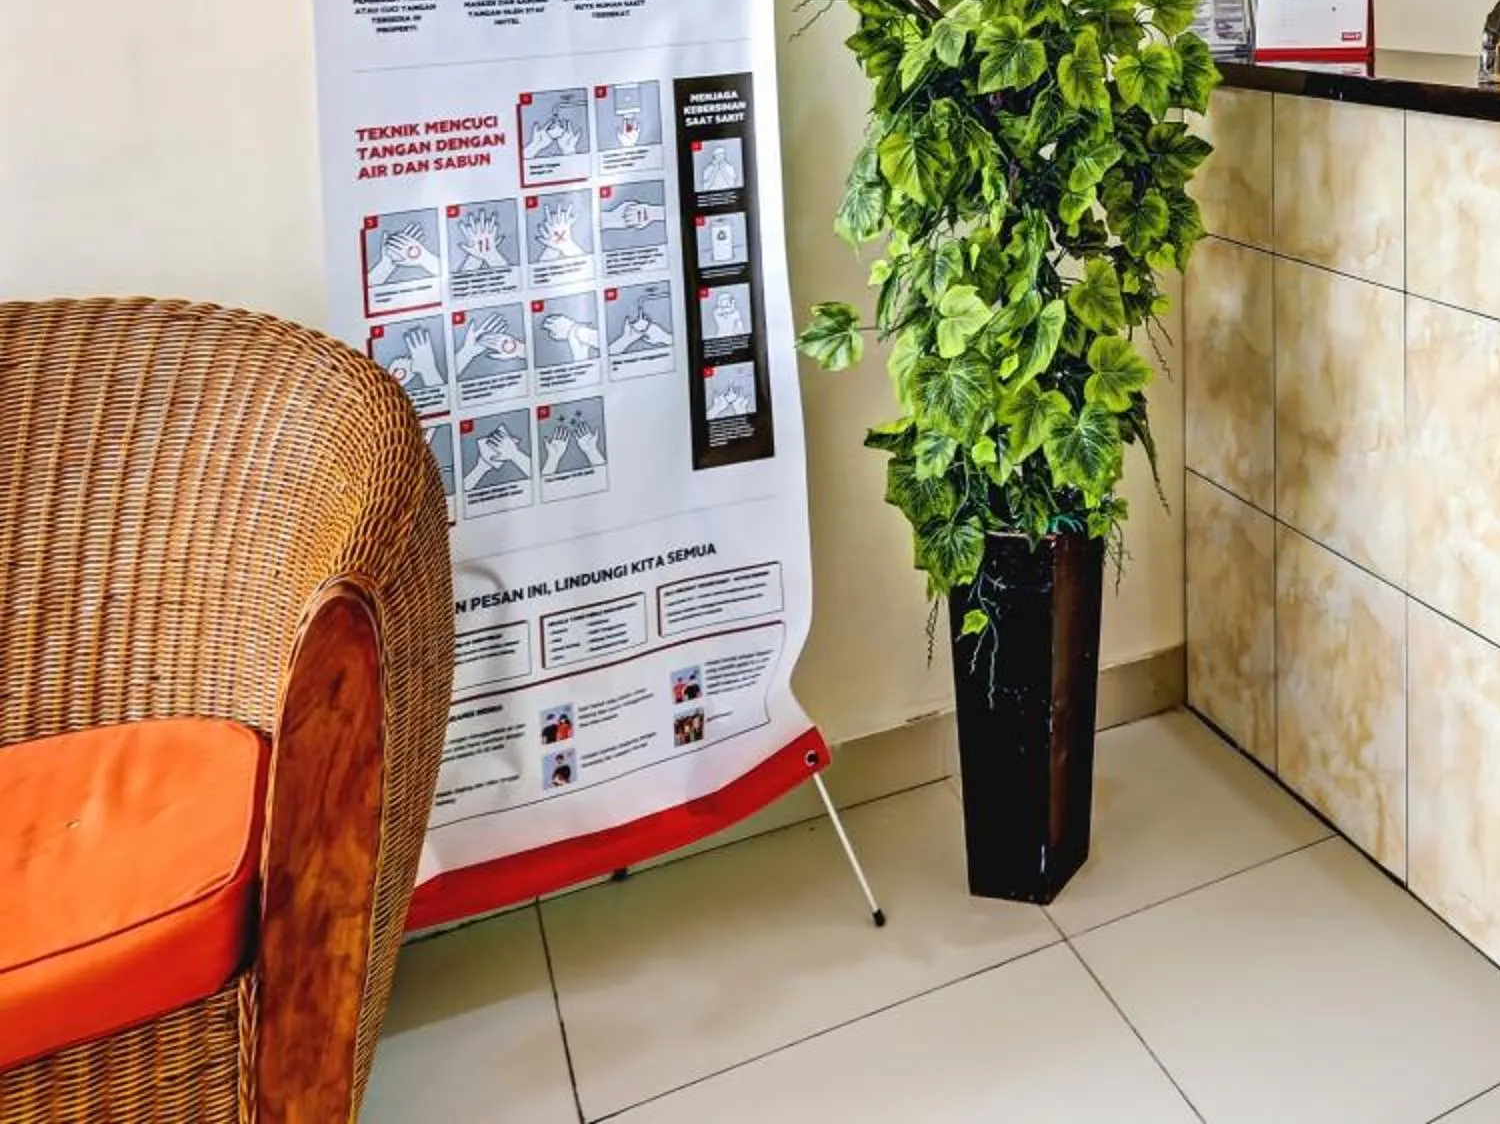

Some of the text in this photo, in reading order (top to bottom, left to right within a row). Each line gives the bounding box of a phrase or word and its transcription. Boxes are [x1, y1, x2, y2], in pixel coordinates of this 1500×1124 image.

[355, 115, 498, 142] TEKNIK MENCUCI
[685, 115, 713, 127] SAAT
[356, 134, 505, 160] TANGAN DENGAN
[358, 153, 490, 180] AIR DAN SABUN
[470, 588, 524, 611] PESAN
[527, 582, 552, 598] INI,
[555, 566, 628, 593] LINDUNGI
[631, 555, 665, 574] KITA
[667, 543, 717, 565] SEMUA
